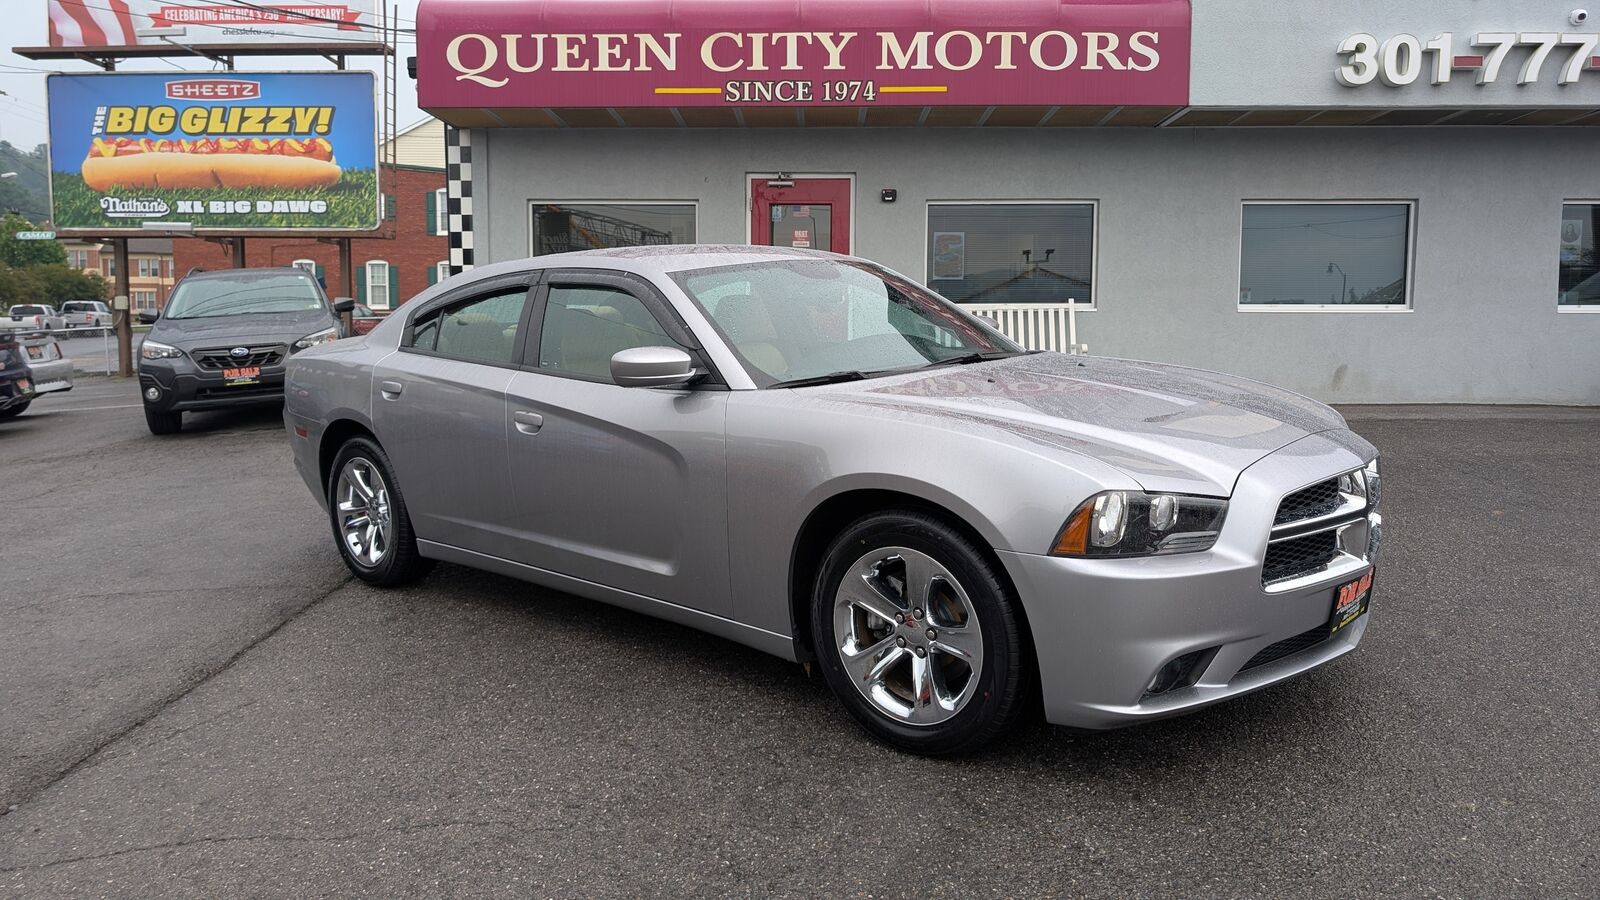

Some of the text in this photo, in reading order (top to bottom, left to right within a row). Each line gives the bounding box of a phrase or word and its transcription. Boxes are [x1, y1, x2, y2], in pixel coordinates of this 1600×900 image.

[164, 9, 217, 21] CELEBRATING
[446, 30, 1160, 88] QUEEN CITY MOTORS
[1335, 32, 1600, 88] 301-777
[172, 84, 254, 96] SHEETZ
[725, 80, 876, 102] SINCE 1974
[92, 106, 107, 135] THE
[105, 106, 334, 134] BIG GLIZZY!
[100, 197, 171, 214] Nathan's
[176, 201, 327, 213] XL BIG DAWG
[223, 369, 240, 378] FOR
[240, 367, 260, 376] SALE
[1336, 582, 1358, 609] FOR
